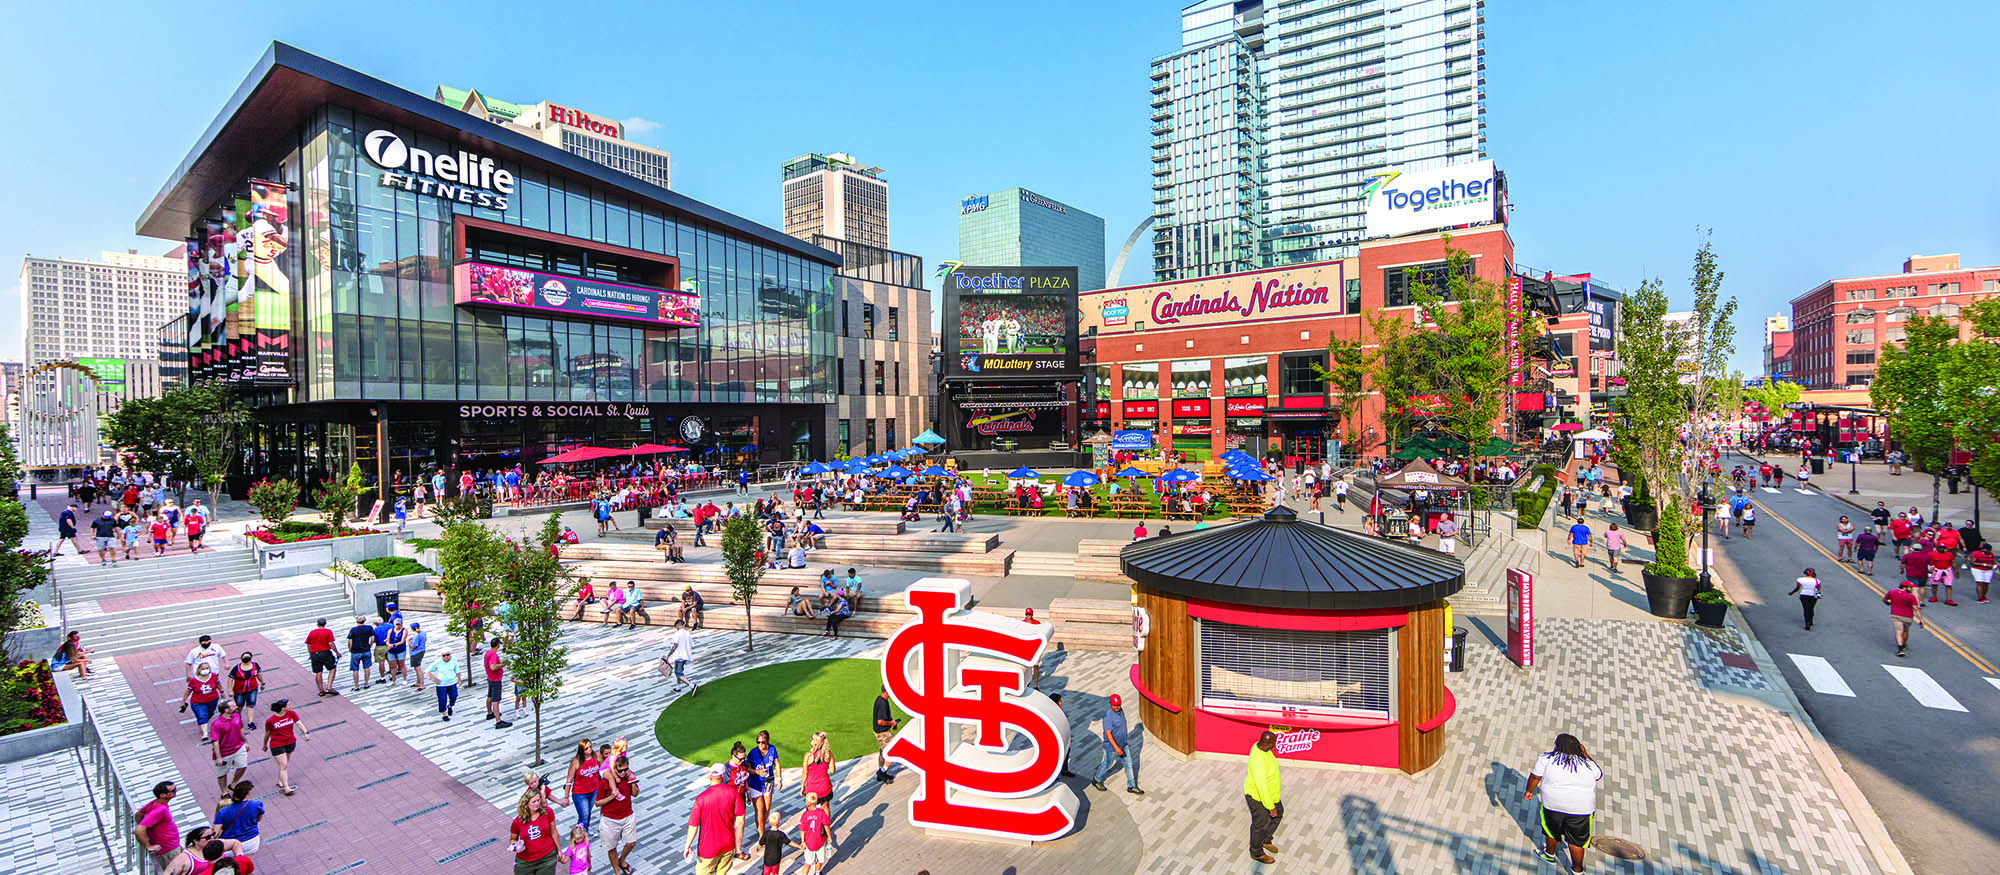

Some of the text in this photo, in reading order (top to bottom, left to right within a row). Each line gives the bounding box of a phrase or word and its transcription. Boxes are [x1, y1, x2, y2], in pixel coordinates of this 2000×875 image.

[549, 104, 618, 138] Hilton
[382, 172, 509, 211] FITNESS
[1382, 178, 1493, 213] Together
[960, 201, 986, 215] KPMG
[1433, 196, 1489, 210] CREDIT UNION
[576, 286, 606, 297] CARDINALS
[606, 290, 625, 300] NATION
[952, 273, 1070, 293] Together PLAZA
[1510, 282, 1520, 303] HALL
[1151, 278, 1329, 325] Cardinals Nation
[983, 358, 1065, 371] MOLottery STAGE
[459, 402, 650, 420] SPORTS & SOCIAL St. Louis
[977, 415, 1034, 435] Cardinals
[1522, 580, 1531, 614] VILLAGE
[1522, 618, 1531, 661] BALLPARK
[1275, 729, 1319, 745] Prairie
[1277, 741, 1312, 753] Farms
[809, 820, 816, 832] 4
